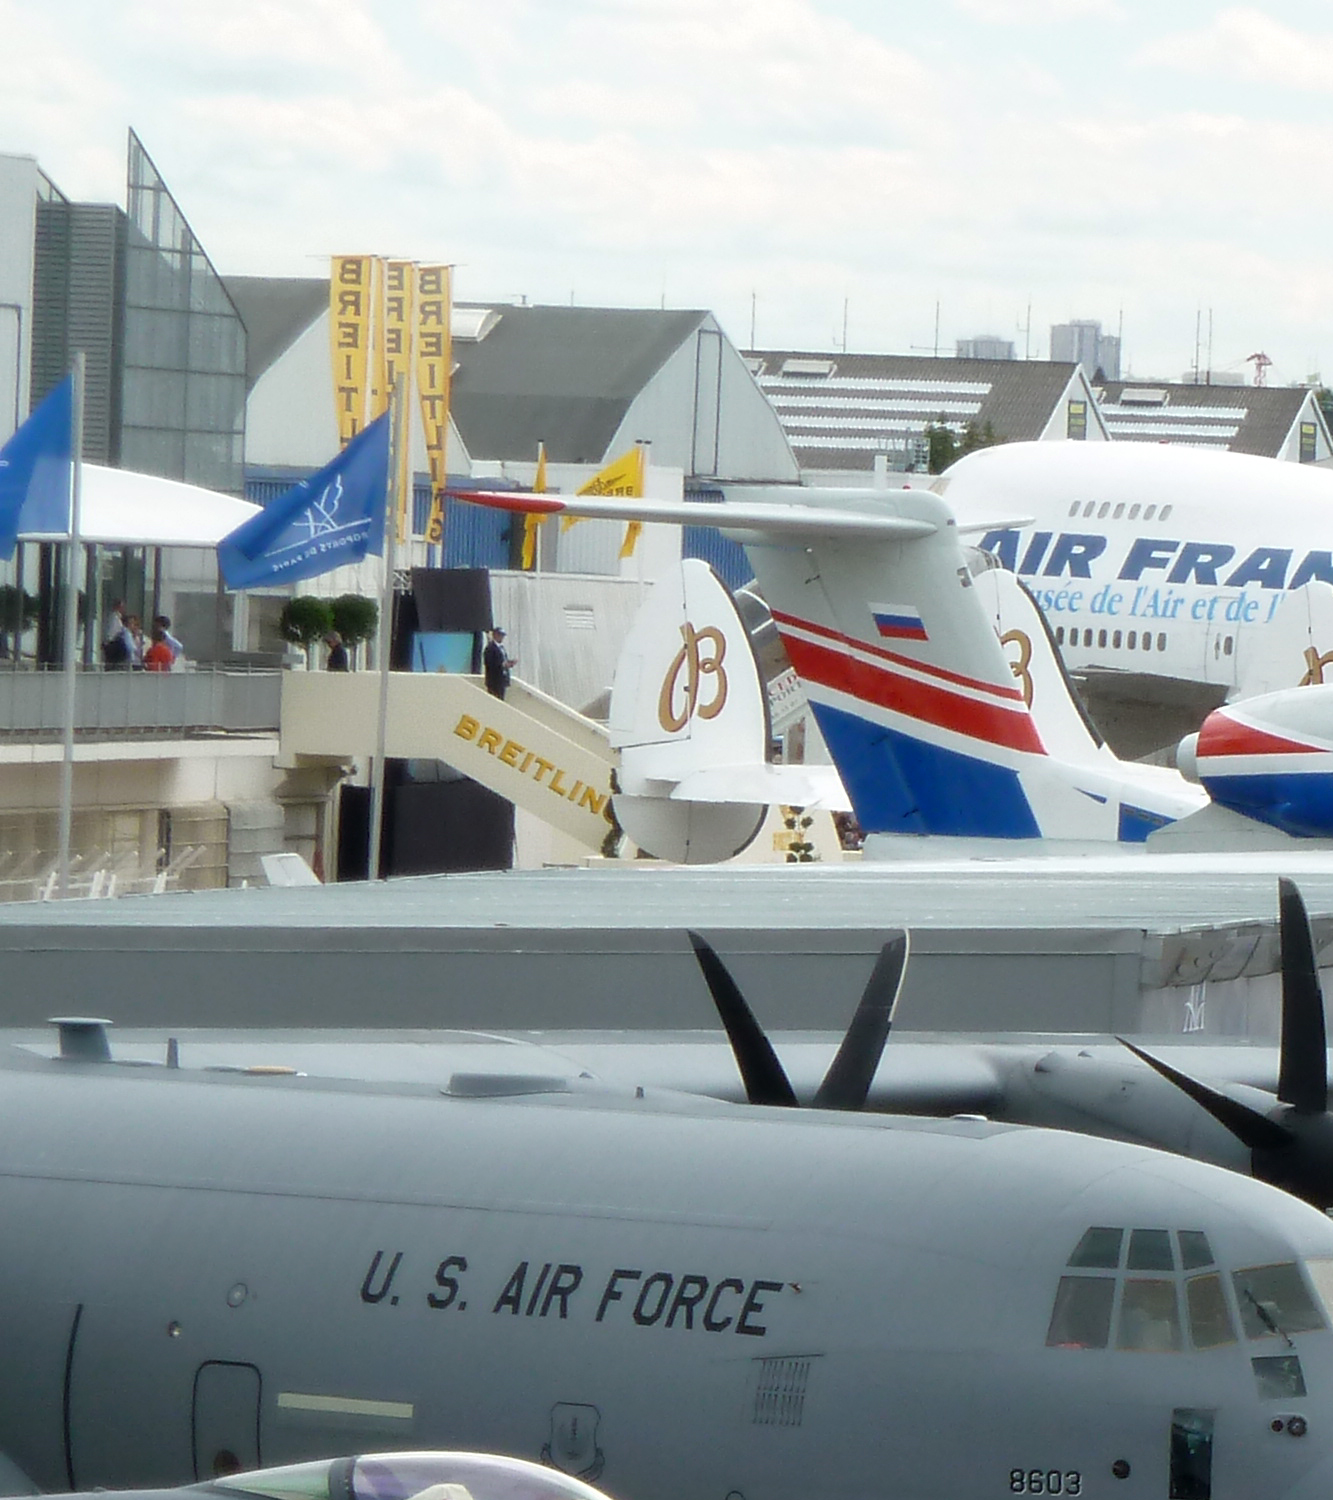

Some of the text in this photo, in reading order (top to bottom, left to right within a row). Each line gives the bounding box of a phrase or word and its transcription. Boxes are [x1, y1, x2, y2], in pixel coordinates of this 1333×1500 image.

[977, 529, 1107, 579] AIR
[1024, 581, 1084, 612] usée
[1089, 583, 1124, 616] de
[1128, 586, 1185, 619] l'Air
[1190, 594, 1219, 620] et
[1225, 592, 1260, 623] de
[359, 1250, 784, 1336] U. S. AIR FORCE
[1009, 1468, 1083, 1497] 8603
